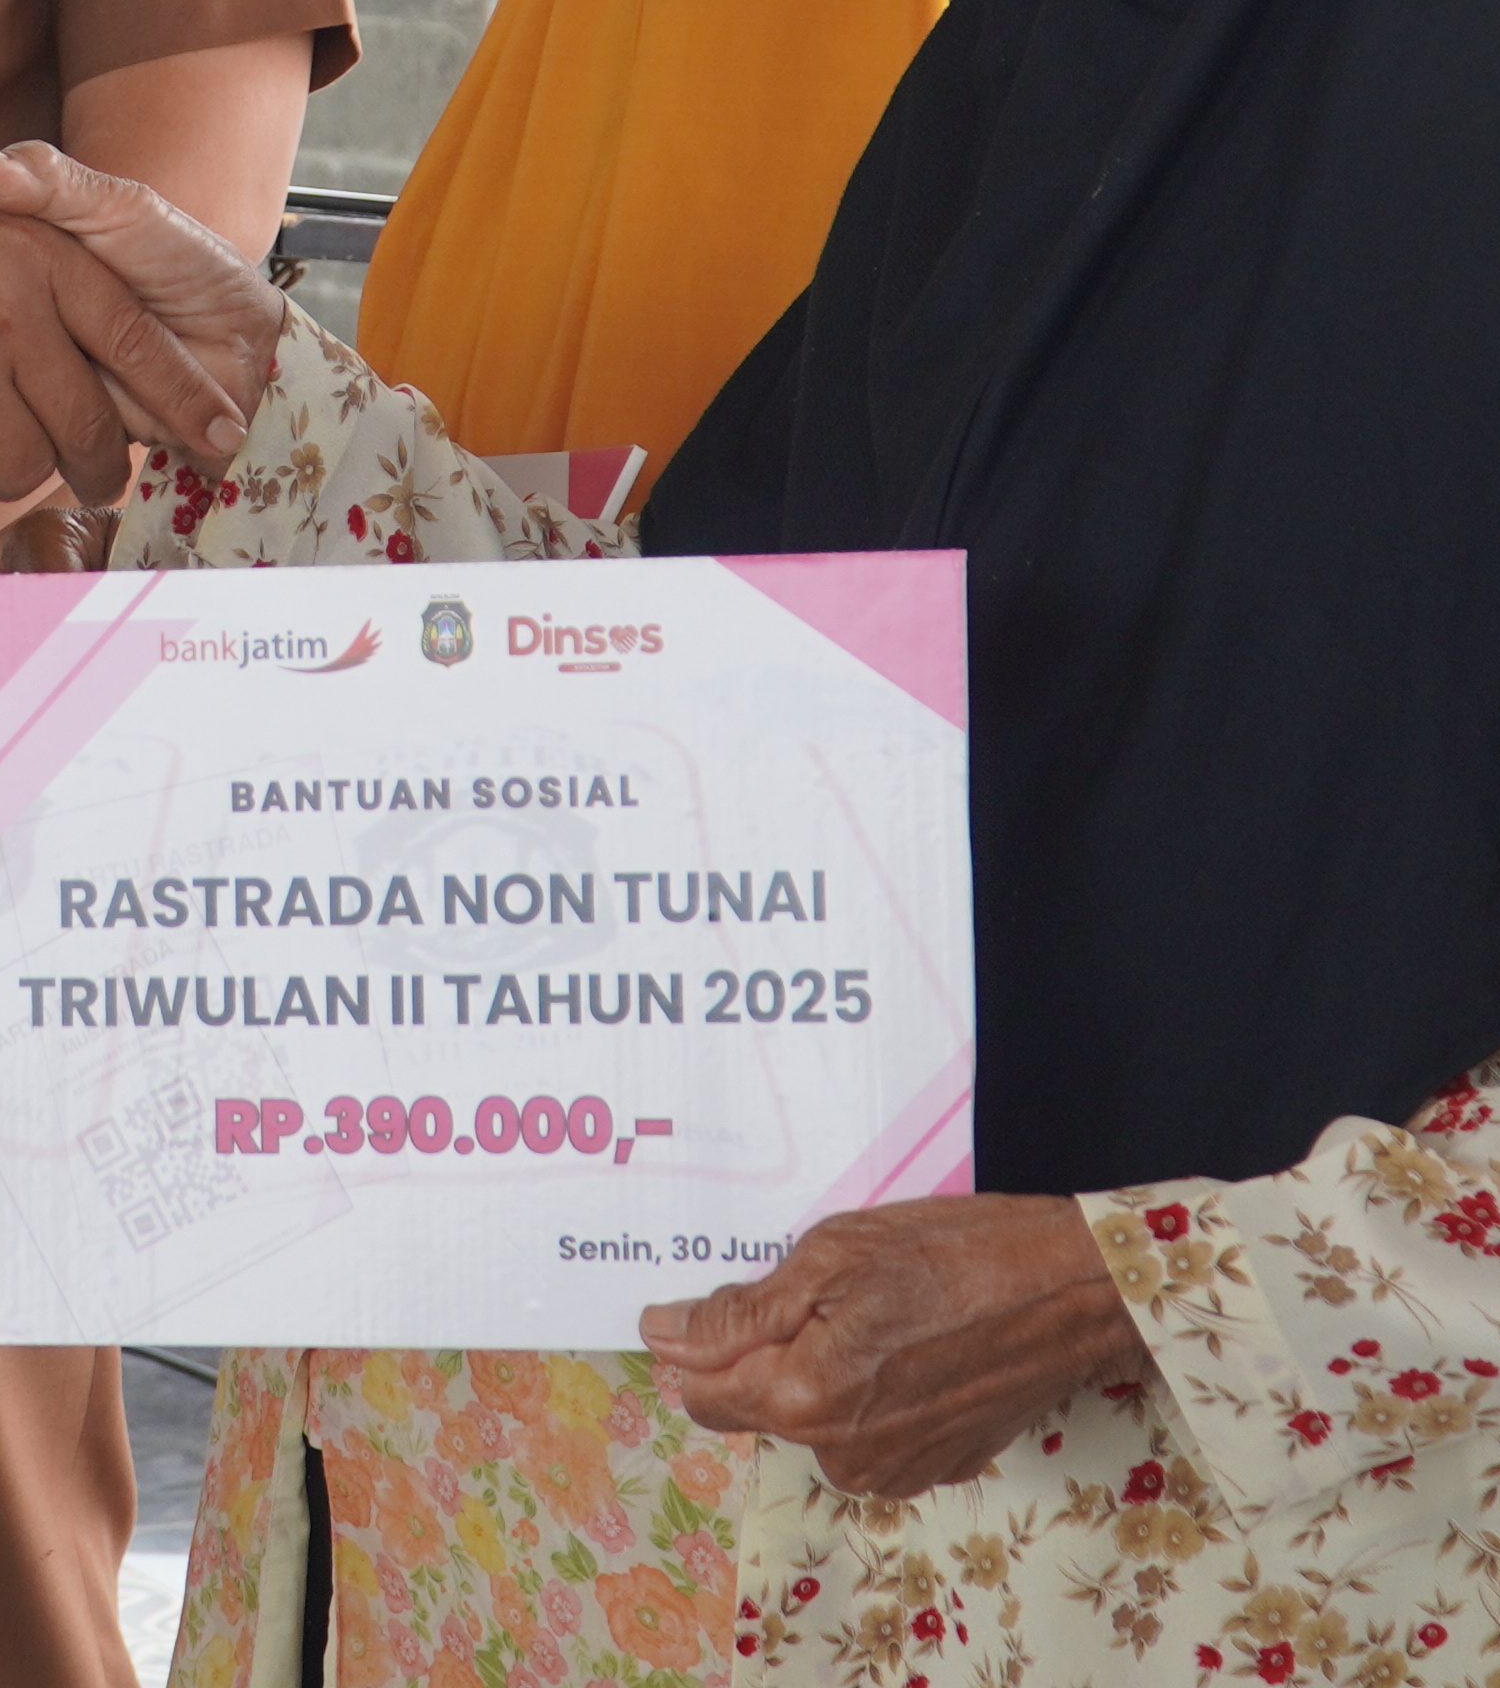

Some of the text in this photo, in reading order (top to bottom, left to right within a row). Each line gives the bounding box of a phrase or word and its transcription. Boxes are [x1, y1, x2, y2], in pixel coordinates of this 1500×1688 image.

[158, 629, 329, 670] bankjatim
[232, 776, 637, 812] BANTUAN SOSIAL
[60, 871, 825, 928] RASTRADA NON TUNAI
[19, 969, 871, 1027] TRIWULAN II TAHUN 2025
[215, 1096, 672, 1164] RP.390.000,-
[559, 1233, 660, 1265] Senin,
[673, 1235, 711, 1261] 30
